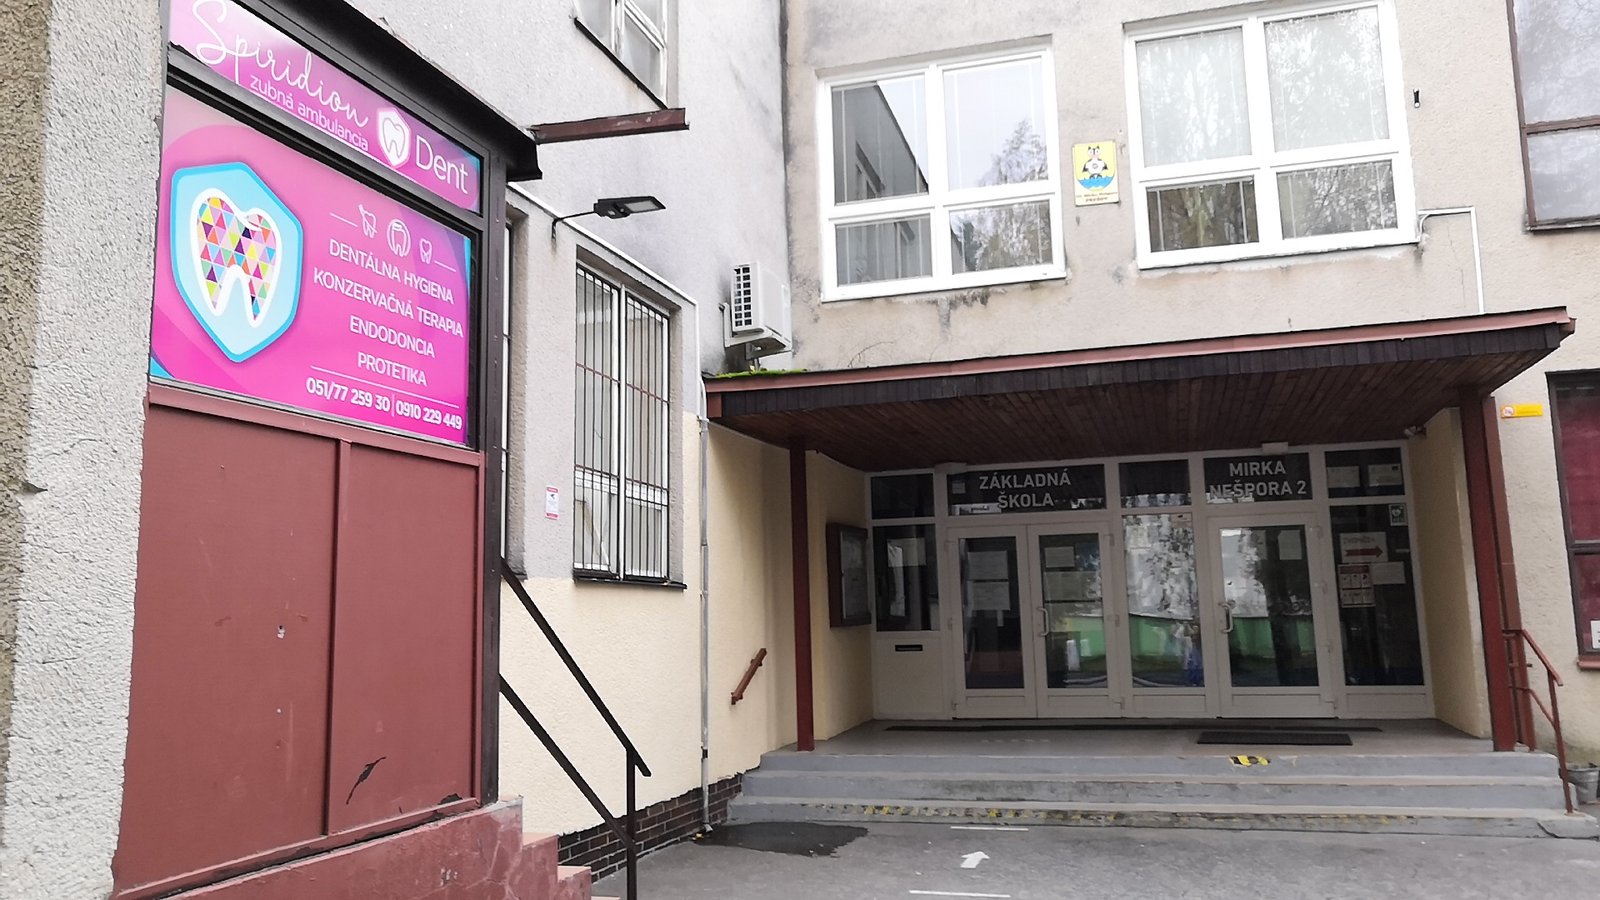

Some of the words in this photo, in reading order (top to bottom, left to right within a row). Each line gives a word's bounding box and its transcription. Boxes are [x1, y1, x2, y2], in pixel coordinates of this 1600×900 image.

[192, 0, 368, 128] Spiridion
[415, 134, 469, 195] Dent
[250, 74, 294, 110] zubná
[297, 102, 369, 152] ambulancia
[329, 238, 400, 282] DENTÁLNA
[403, 270, 454, 304] HYGIENA
[313, 267, 414, 319] KONZERVAČNÁ
[416, 306, 464, 338] TERAPIA
[349, 315, 435, 358] ENDODONCIA
[357, 351, 427, 387] PROTETIKA
[306, 377, 349, 401] 051/77
[350, 388, 373, 408] 259
[375, 396, 391, 412] 30
[395, 399, 421, 419] 0910
[423, 407, 442, 424] 229
[443, 412, 463, 430] 449
[979, 468, 1072, 490] ZÁKLADNÁ
[1208, 479, 1293, 500] NEŠPORA
[1297, 480, 1307, 495] 2
[1229, 460, 1287, 477] MIRKA
[997, 491, 1054, 509] ŠKOLA
